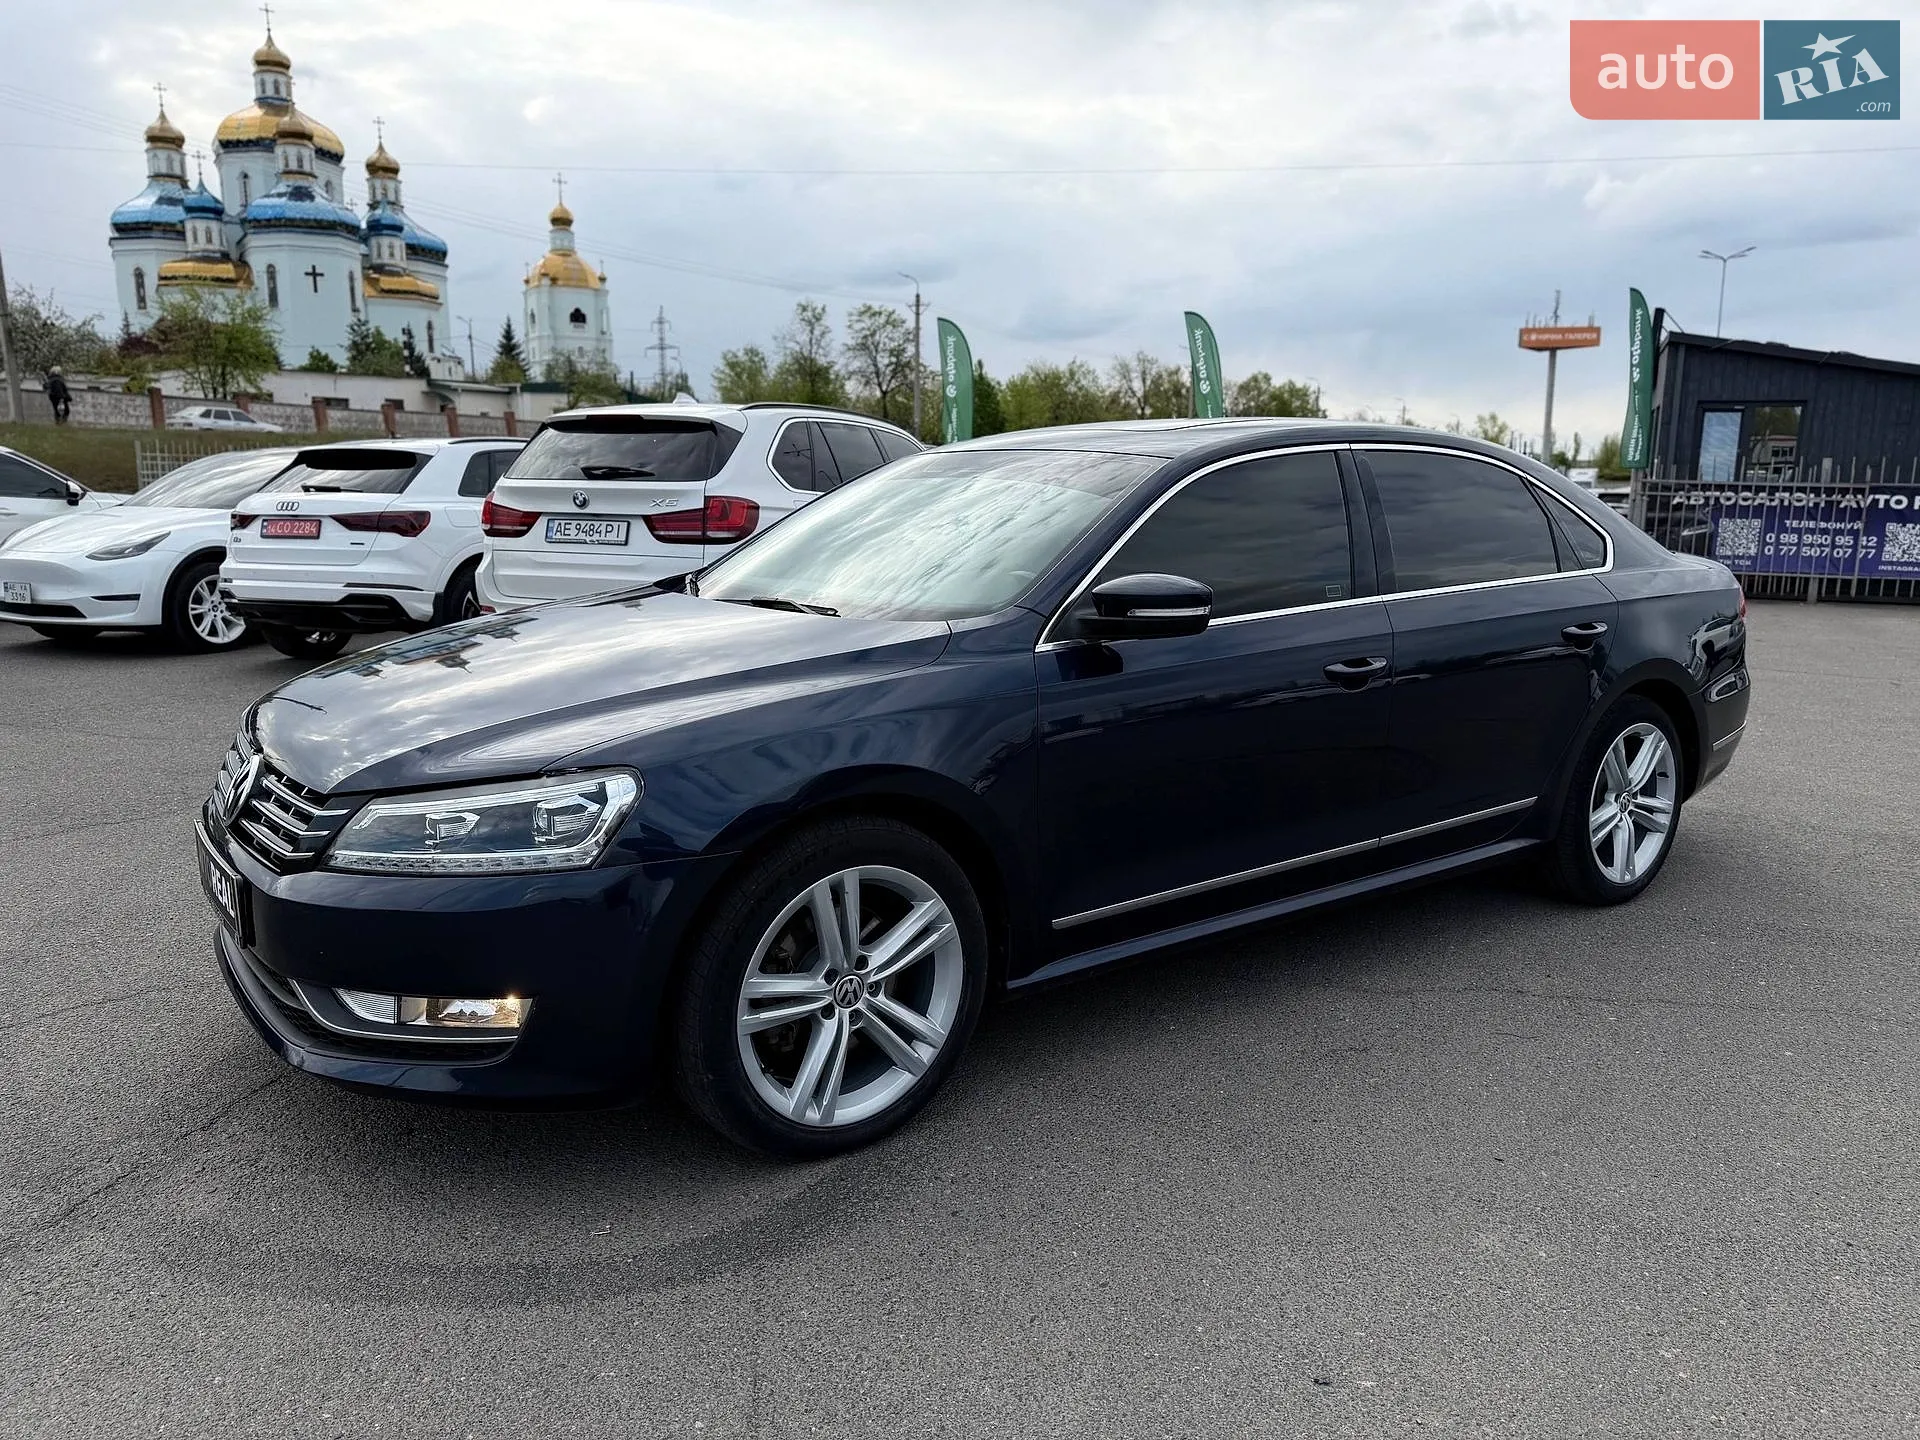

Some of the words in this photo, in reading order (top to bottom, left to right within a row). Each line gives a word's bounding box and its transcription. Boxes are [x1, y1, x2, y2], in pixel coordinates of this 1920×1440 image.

[649, 498, 679, 508] X5
[1671, 492, 1825, 507] АВТОСАЛОН
[293, 521, 317, 534] 2284
[554, 522, 572, 537] AE
[574, 523, 603, 538] 9484
[1766, 532, 1775, 543] 0
[1779, 533, 1799, 544] 98
[1803, 534, 1831, 545] 950
[1834, 535, 1854, 546] 95
[1764, 545, 1774, 556] 0
[1778, 545, 1798, 556] 77
[1801, 546, 1829, 557] 507
[1832, 548, 1853, 559] 07
[209, 860, 235, 919] REAL
